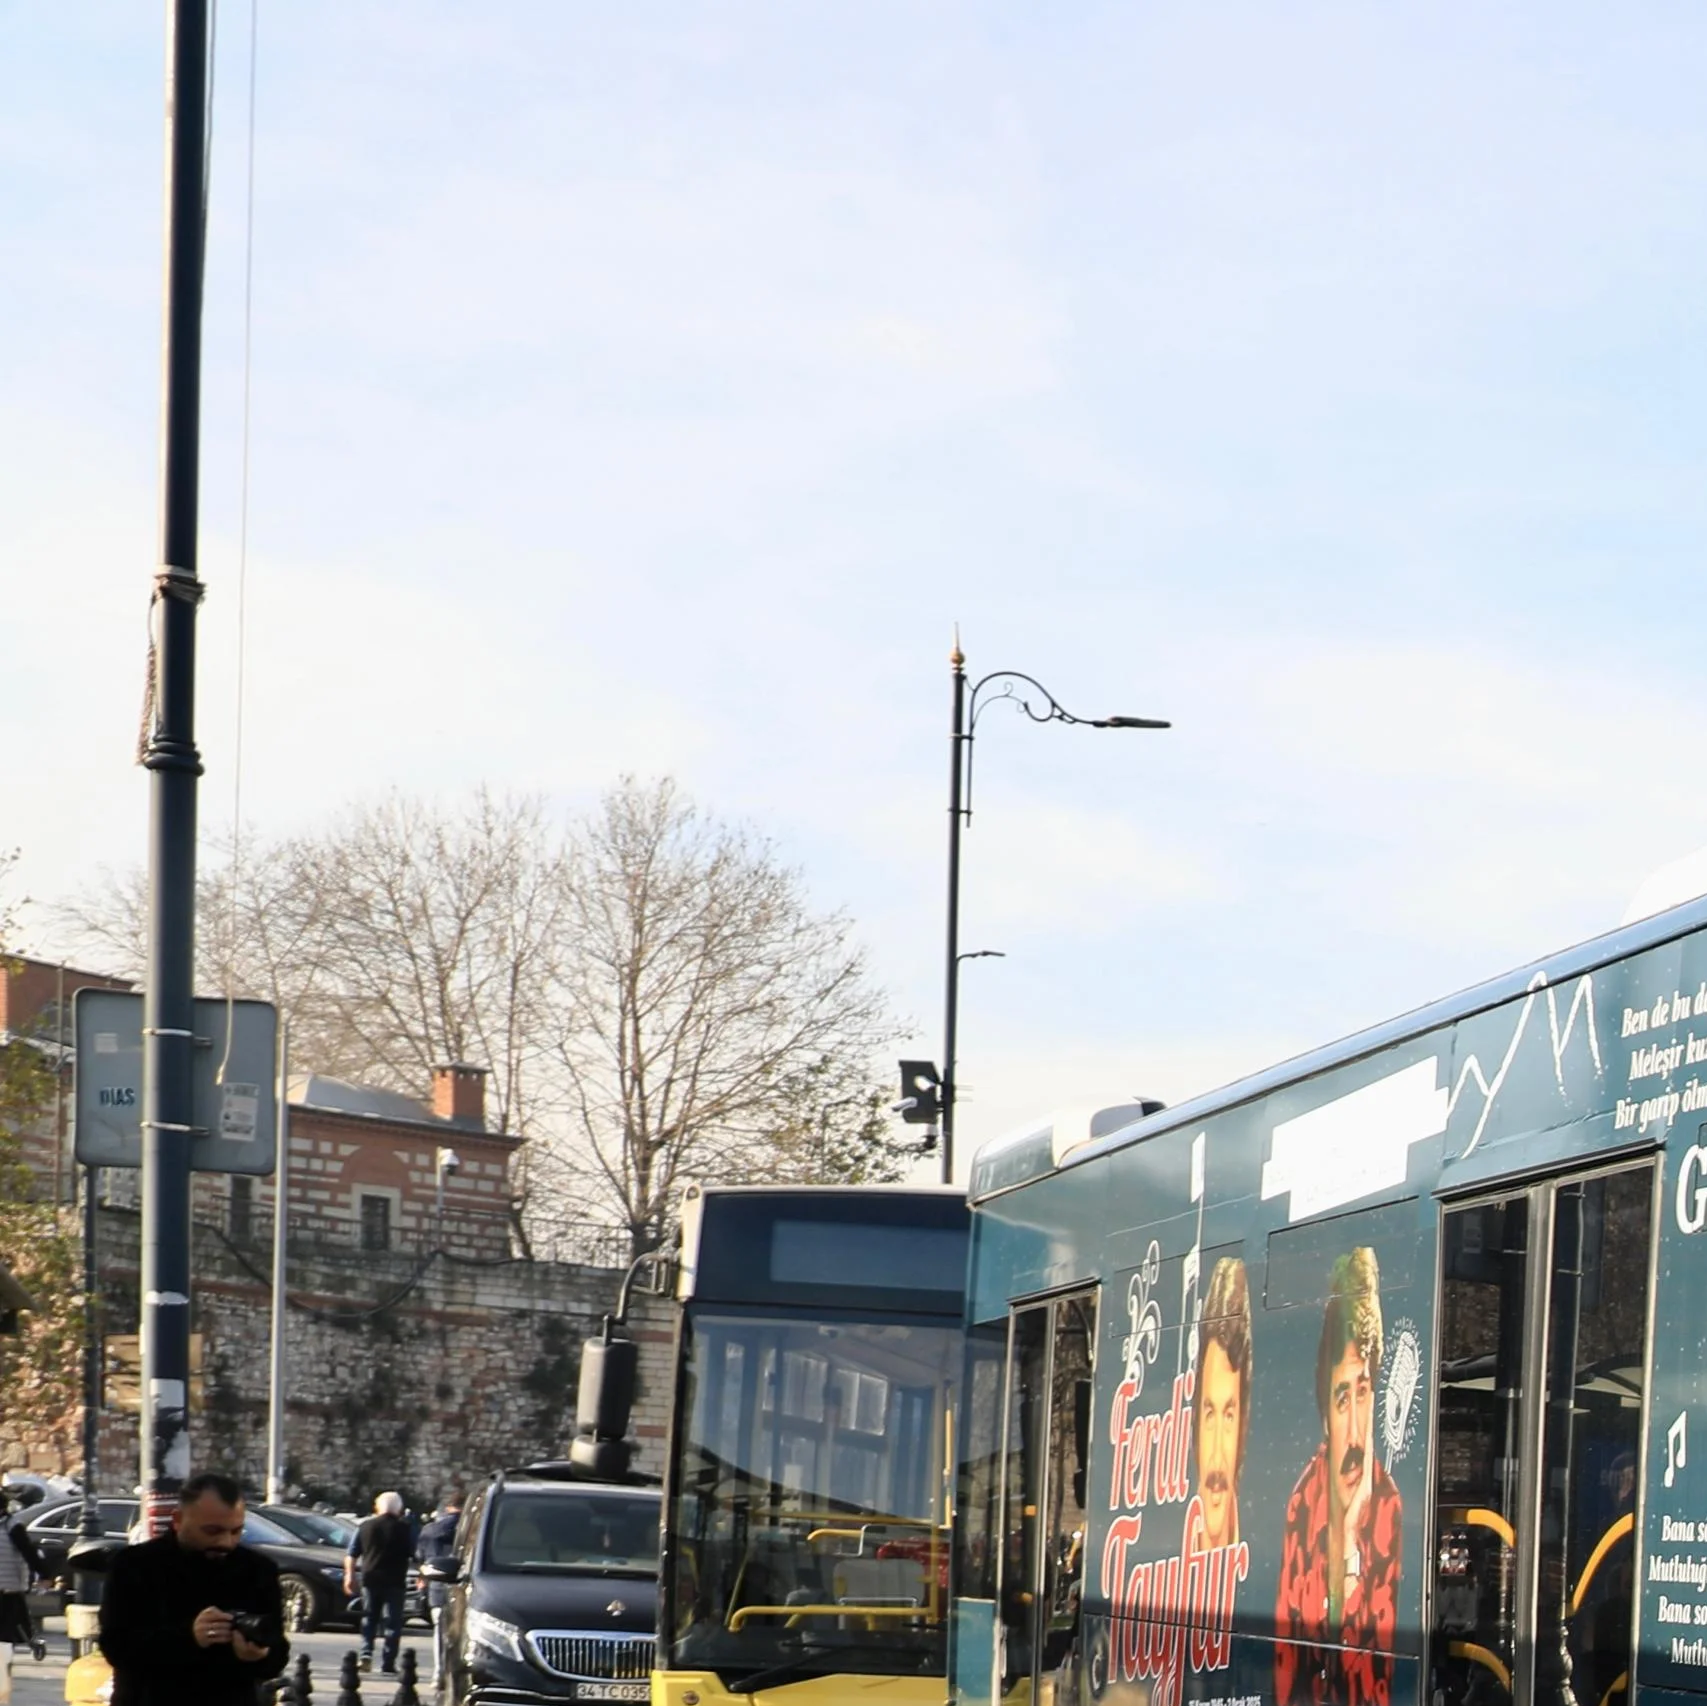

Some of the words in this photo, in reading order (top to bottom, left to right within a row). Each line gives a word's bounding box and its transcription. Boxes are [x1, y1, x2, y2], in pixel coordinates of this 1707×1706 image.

[1621, 1008, 1648, 1038] Ben
[1651, 996, 1669, 1028] de
[1671, 991, 1691, 1022] bu
[1628, 1039, 1684, 1081] Meleşir
[1614, 1097, 1638, 1129] Bir
[1638, 1087, 1679, 1133] garip
[1109, 1368, 1197, 1513] Ferdi
[1661, 1515, 1694, 1543] Bana
[1658, 1595, 1691, 1624] Bana
[578, 1684, 595, 1697] 34
[600, 1684, 619, 1698] TC
